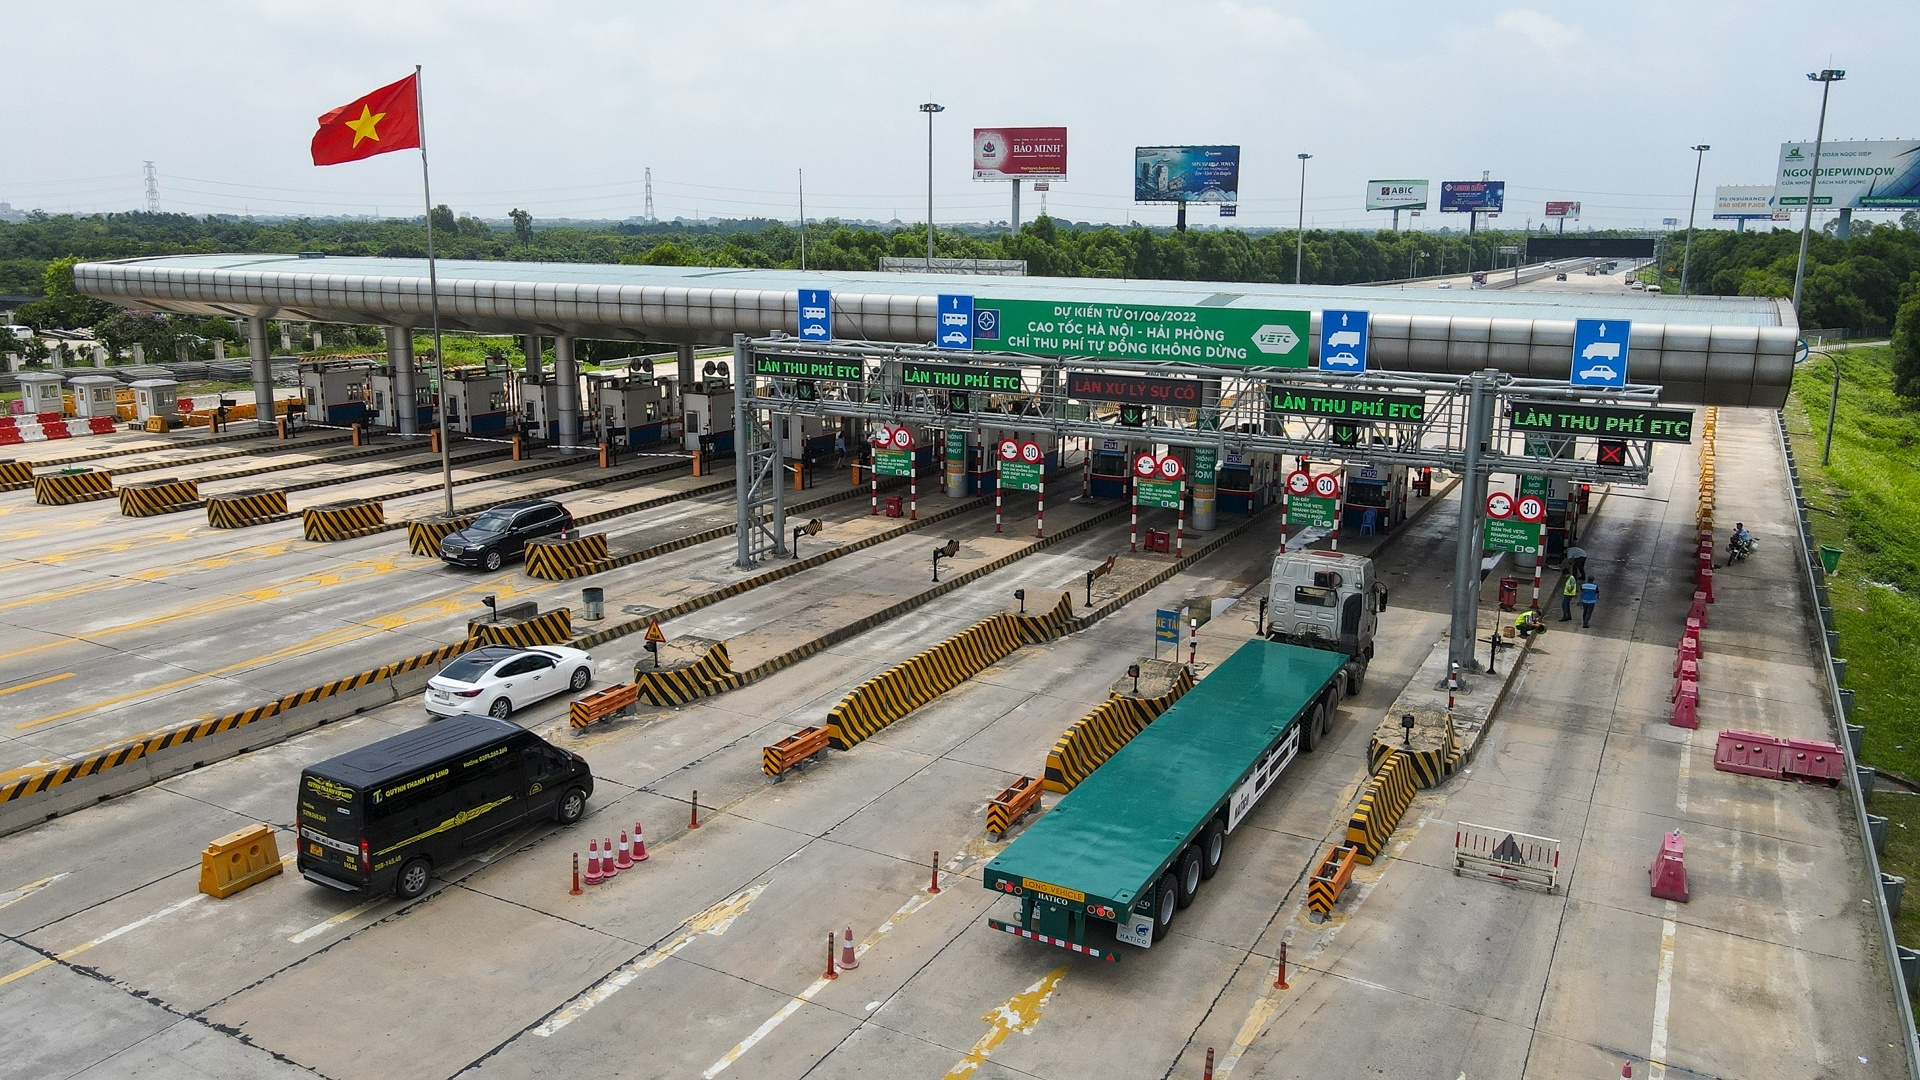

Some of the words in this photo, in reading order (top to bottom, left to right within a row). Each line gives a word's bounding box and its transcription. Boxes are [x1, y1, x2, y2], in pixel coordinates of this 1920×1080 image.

[1013, 142, 1032, 153] BẢO
[1034, 145, 1060, 153] MINH
[1391, 186, 1413, 194] ABIC
[1054, 306, 1072, 319] DỰ
[1074, 304, 1102, 318] KIẾN
[1106, 306, 1122, 319] TỪ
[1124, 310, 1197, 322] 01/06/2022
[1027, 321, 1054, 333] CAO
[1057, 319, 1083, 334] TỐC
[1087, 321, 1106, 335] HÀ
[1109, 323, 1133, 339] NỘI
[1146, 324, 1170, 339] HẢI
[1175, 326, 1225, 341] PHÒNG
[1008, 333, 1030, 347] CHỈ
[1033, 337, 1058, 348] THU
[1062, 337, 1084, 350] PHÍ
[1087, 340, 1105, 354] TỰ
[1108, 339, 1147, 355] ĐỘNG
[1152, 342, 1202, 357] KHÔNG
[1206, 344, 1247, 359] DỪNG
[1260, 334, 1291, 343] VETC
[758, 357, 781, 373] LÀN
[783, 362, 807, 374] THU
[811, 361, 833, 377] PHÍ
[837, 365, 860, 379] ETC
[904, 367, 930, 384] LÀN
[933, 372, 960, 387] THU
[964, 371, 990, 388] PHÍ
[993, 376, 1019, 390] ETC
[1075, 378, 1102, 393] LÀN
[1129, 380, 1147, 396] LÝ
[1174, 384, 1195, 400] CỐ
[1273, 391, 1306, 410] LÀN
[1311, 397, 1346, 413] THU
[1351, 397, 1384, 416] PHÍ
[1389, 403, 1422, 419] ETC
[1514, 407, 1552, 427] LÀN
[1558, 414, 1599, 431] THU
[1606, 413, 1644, 433] PHÍ
[1650, 419, 1690, 437] ETC
[897, 433, 907, 444] 30
[1025, 447, 1037, 458] 30
[1165, 462, 1176, 473] 30
[1319, 480, 1332, 491] 30
[1523, 502, 1537, 515] 30
[406, 777, 426, 789] THANH
[426, 773, 435, 782] VIP
[435, 768, 449, 779] LIMO
[1025, 880, 1048, 892] LONG
[1050, 887, 1082, 901] VEHICLE
[1037, 892, 1068, 906] HATICO
[1120, 933, 1147, 945] HATICO
